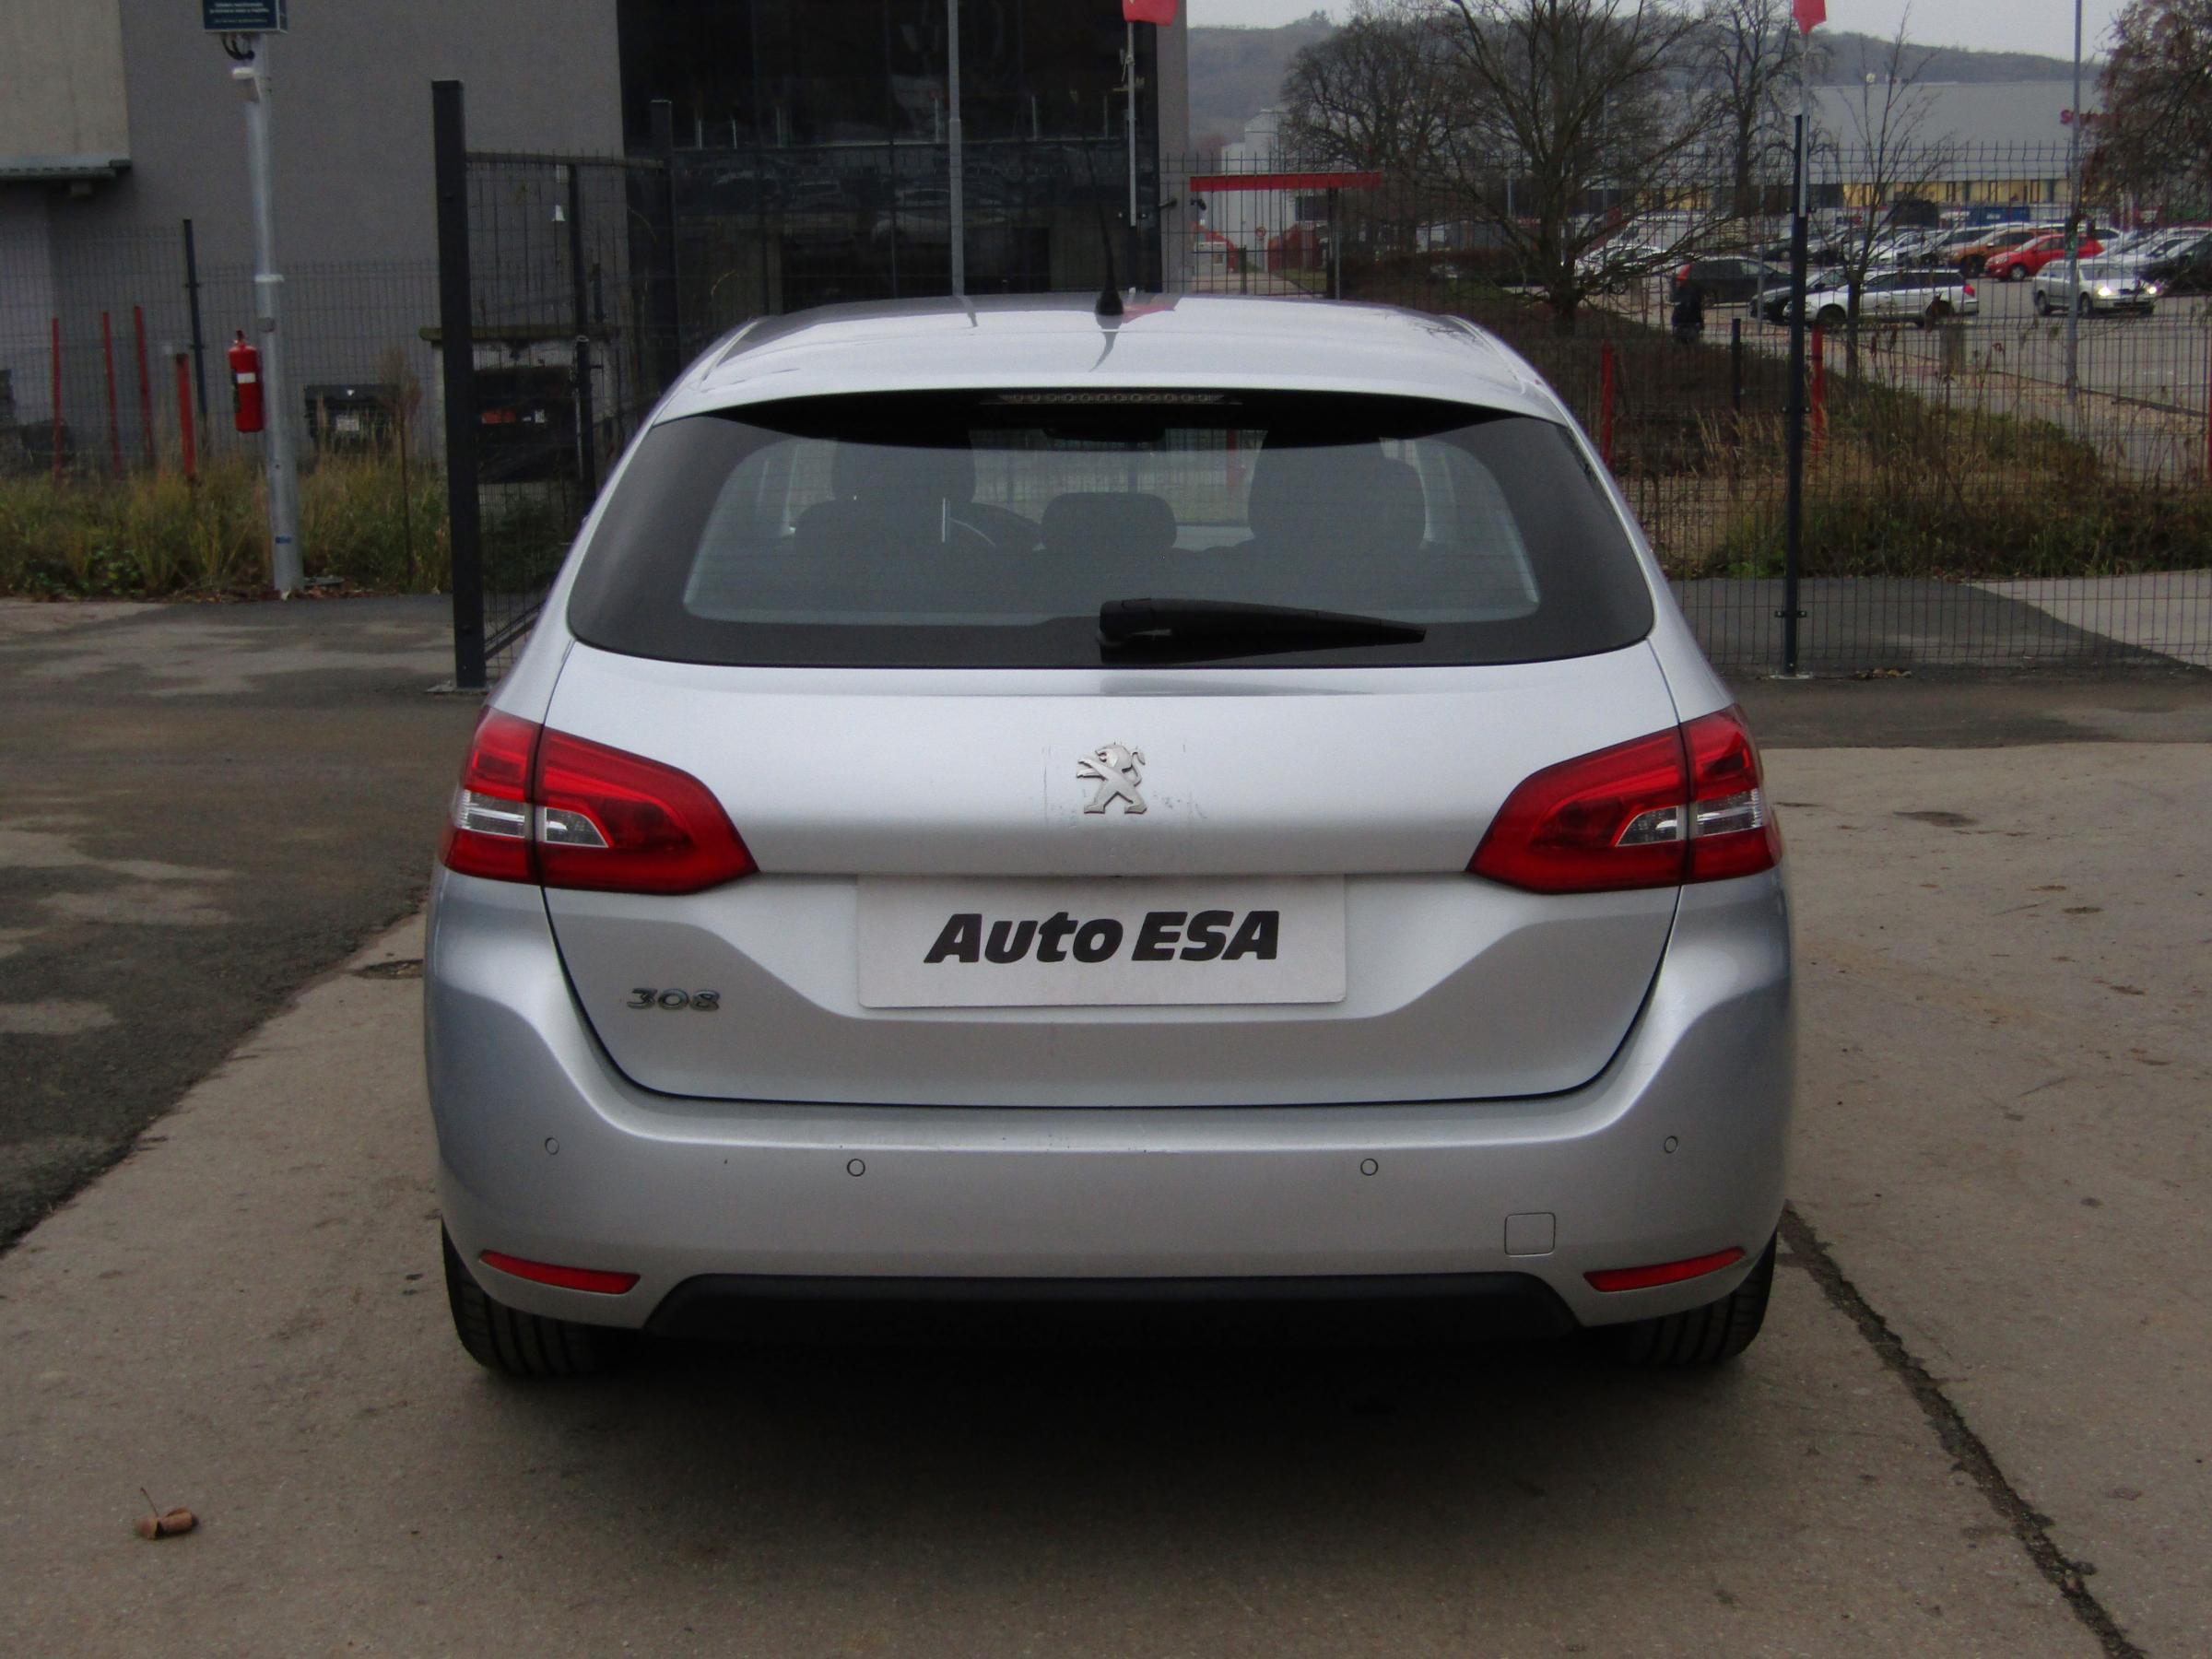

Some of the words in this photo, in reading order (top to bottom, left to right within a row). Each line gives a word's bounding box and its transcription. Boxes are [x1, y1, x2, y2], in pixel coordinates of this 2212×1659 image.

[924, 912, 1124, 963] Auto
[1132, 910, 1279, 960] ESA
[627, 988, 720, 1011] 308
